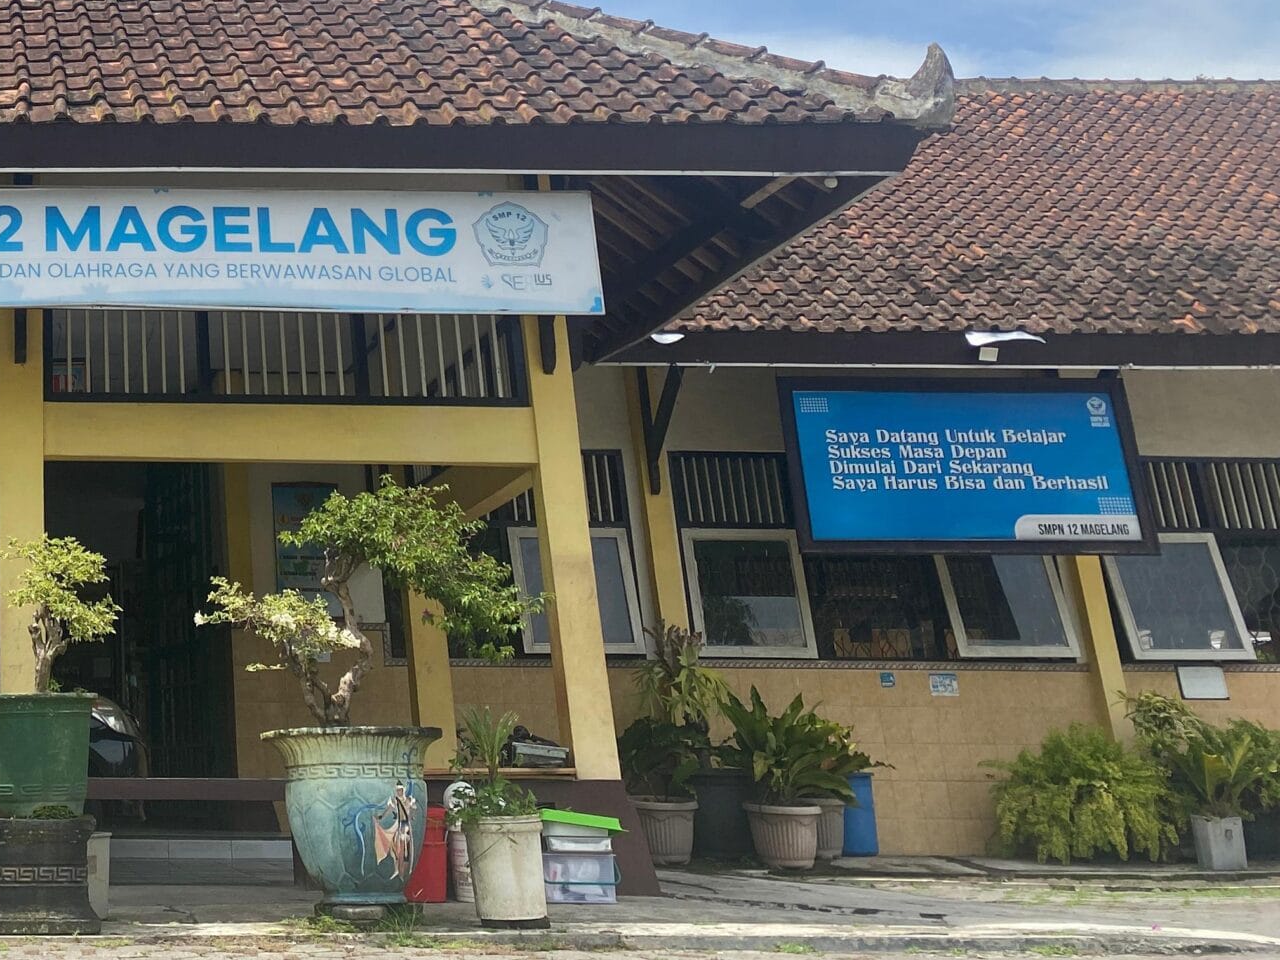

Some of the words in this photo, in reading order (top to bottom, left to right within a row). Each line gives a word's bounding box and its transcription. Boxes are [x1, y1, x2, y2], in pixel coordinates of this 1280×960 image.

[492, 211, 512, 221] SMP
[516, 212, 527, 222] 12
[45, 205, 457, 257] MAGELANG
[0, 263, 41, 278] DAN
[48, 263, 157, 278] OLAHRAGA
[164, 263, 220, 278] YANG
[227, 264, 371, 280] BERWAWASAN
[378, 266, 457, 282] GLOBAL
[825, 429, 870, 445] Saya
[876, 429, 939, 445] Datang
[945, 429, 996, 443] Untuk
[1002, 429, 1066, 445] Belajar
[828, 445, 891, 459] Sukses
[899, 445, 944, 458] Masa
[951, 445, 1007, 460] Depan
[829, 460, 896, 474] Dimulai
[903, 460, 942, 474] Dari
[949, 460, 1034, 476] Sekarang
[832, 476, 877, 492] Saya
[883, 476, 938, 490] Harus
[944, 476, 985, 490] Bisa
[993, 476, 1026, 490] dan
[1032, 475, 1109, 490] Berhasil
[1038, 524, 1064, 535] SMPN
[1067, 524, 1079, 535] 12
[1080, 524, 1129, 535] MAGELANG
